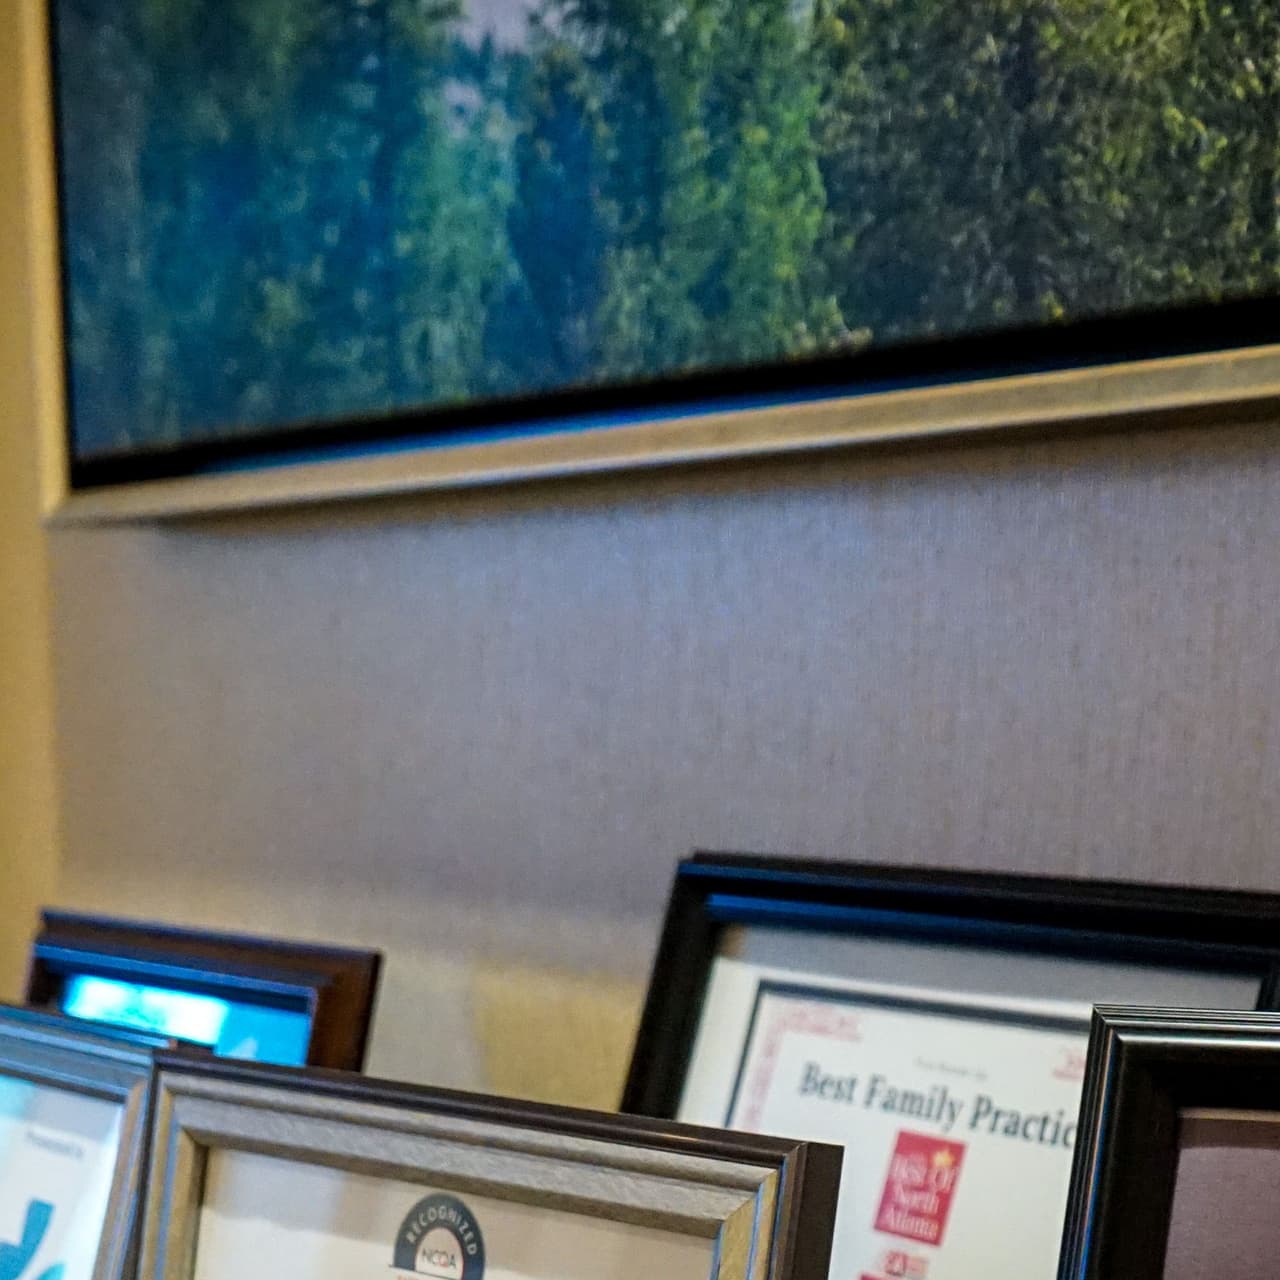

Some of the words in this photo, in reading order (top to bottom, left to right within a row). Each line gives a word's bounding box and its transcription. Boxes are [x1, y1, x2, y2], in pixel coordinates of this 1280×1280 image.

[798, 1061, 857, 1101] Best
[864, 1073, 964, 1130] Family
[970, 1095, 1076, 1147] Practic
[405, 1205, 478, 1255] RECOGNIZED
[422, 1247, 457, 1268] NCQA
